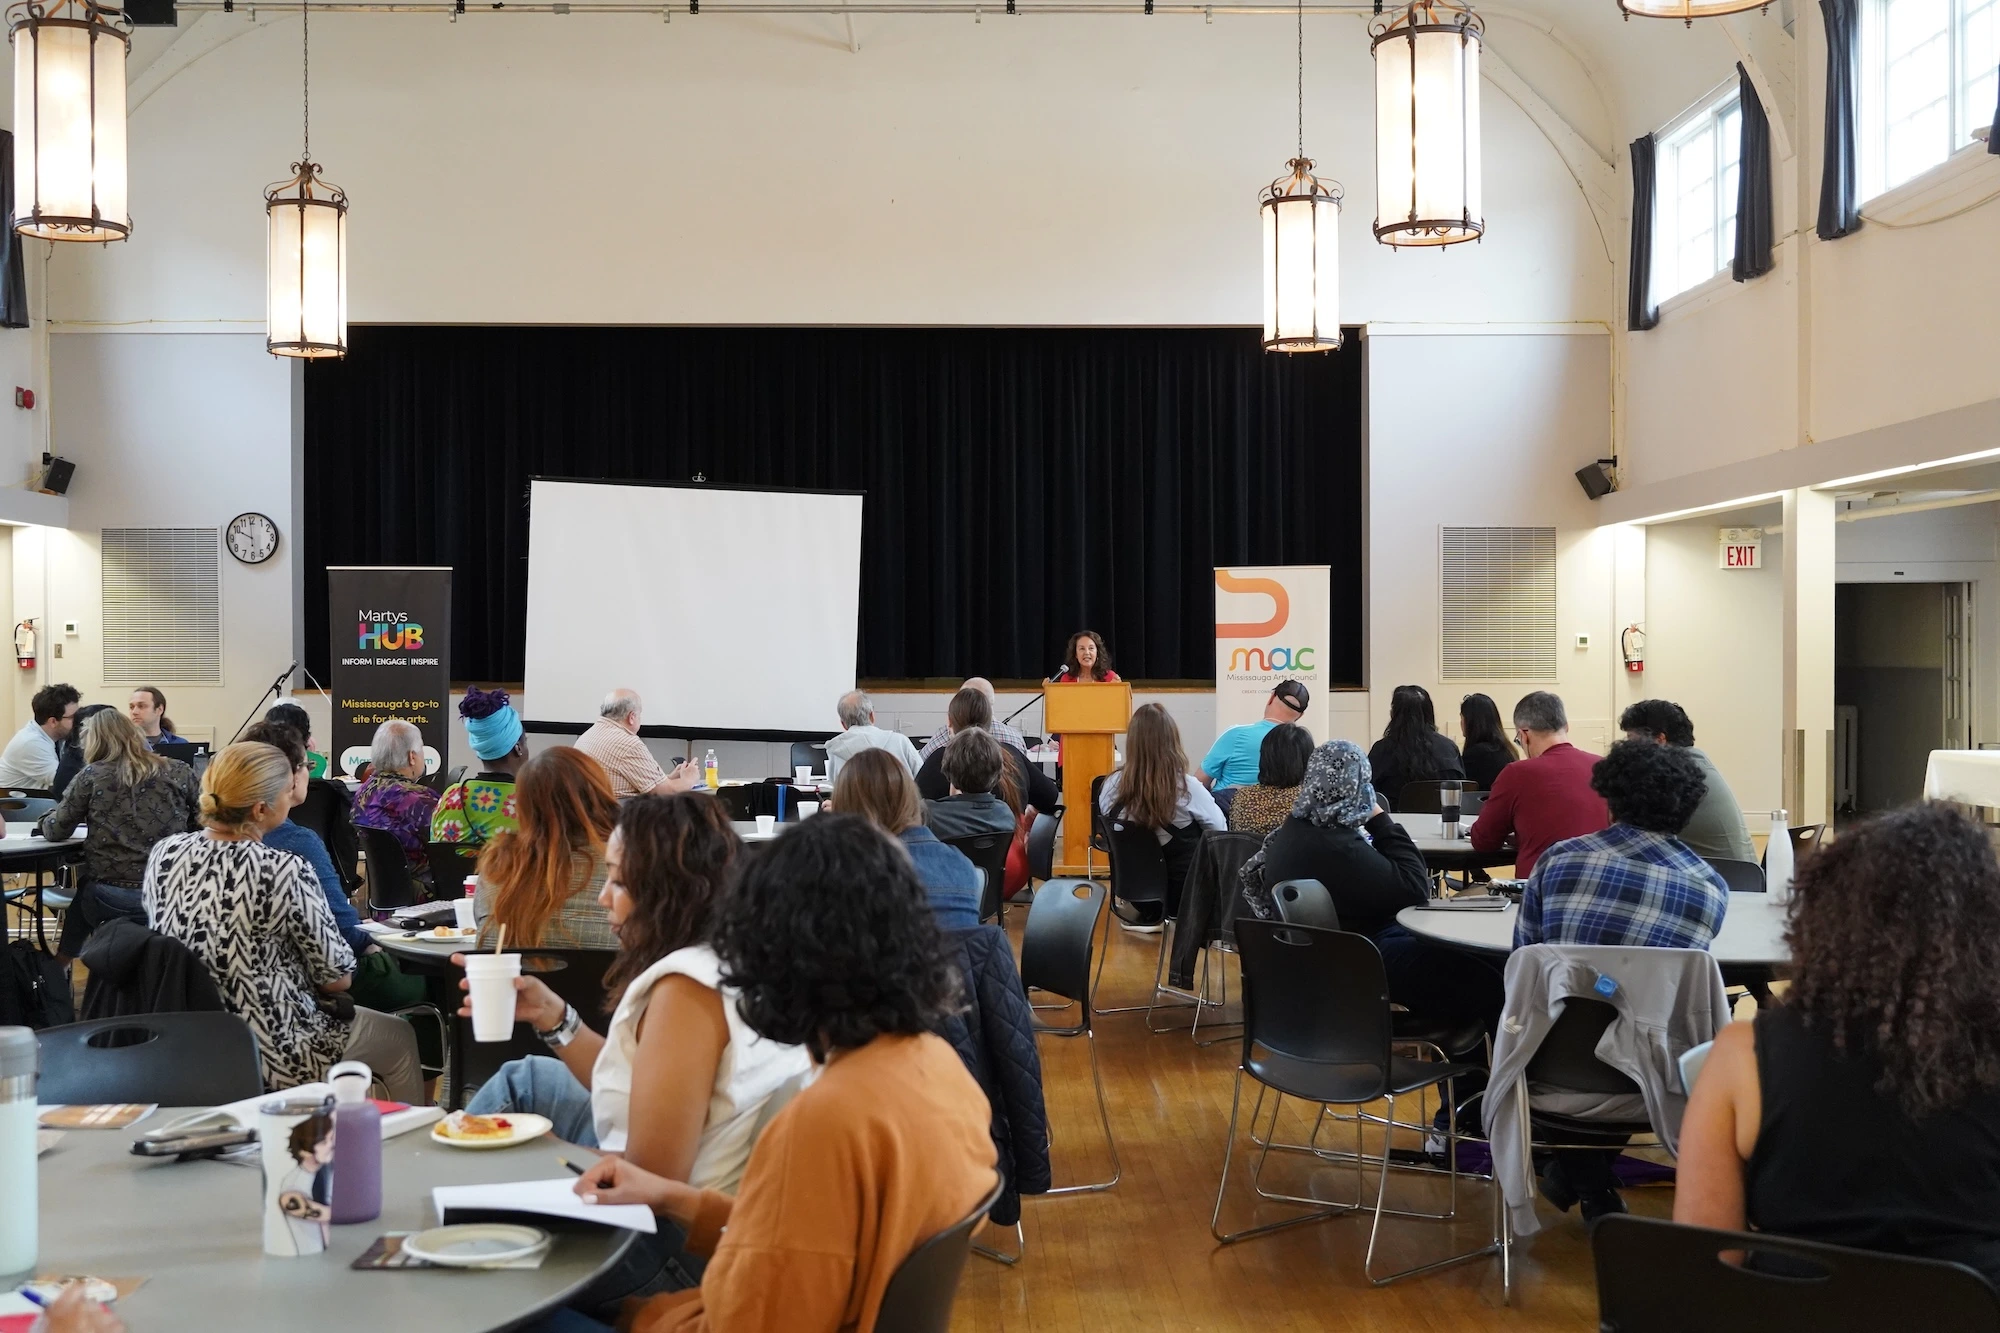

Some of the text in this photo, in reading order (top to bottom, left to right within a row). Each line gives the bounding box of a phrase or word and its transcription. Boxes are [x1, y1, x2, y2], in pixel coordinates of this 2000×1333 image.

[240, 519, 246, 528] 11
[248, 516, 255, 525] 12
[260, 519, 264, 527] 1
[233, 525, 241, 534] 10
[266, 523, 271, 533] 2
[230, 534, 234, 543] 9
[270, 533, 275, 542] 3
[234, 543, 239, 552] 8
[266, 543, 271, 552] 4
[242, 549, 247, 558] 7
[251, 551, 256, 560] 6
[260, 549, 264, 558] 5
[1727, 546, 1756, 566] EXIT
[358, 609, 408, 625] Martys
[359, 623, 424, 650] HUB
[342, 658, 439, 666] INFORM ENGAGE INSPIRE
[1228, 647, 1315, 672] mac
[1226, 673, 1318, 683] Mississauga Arts Council
[412, 699, 439, 711] go-to
[352, 714, 370, 724] site
[372, 714, 387, 724] for
[406, 714, 429, 724] arts.
